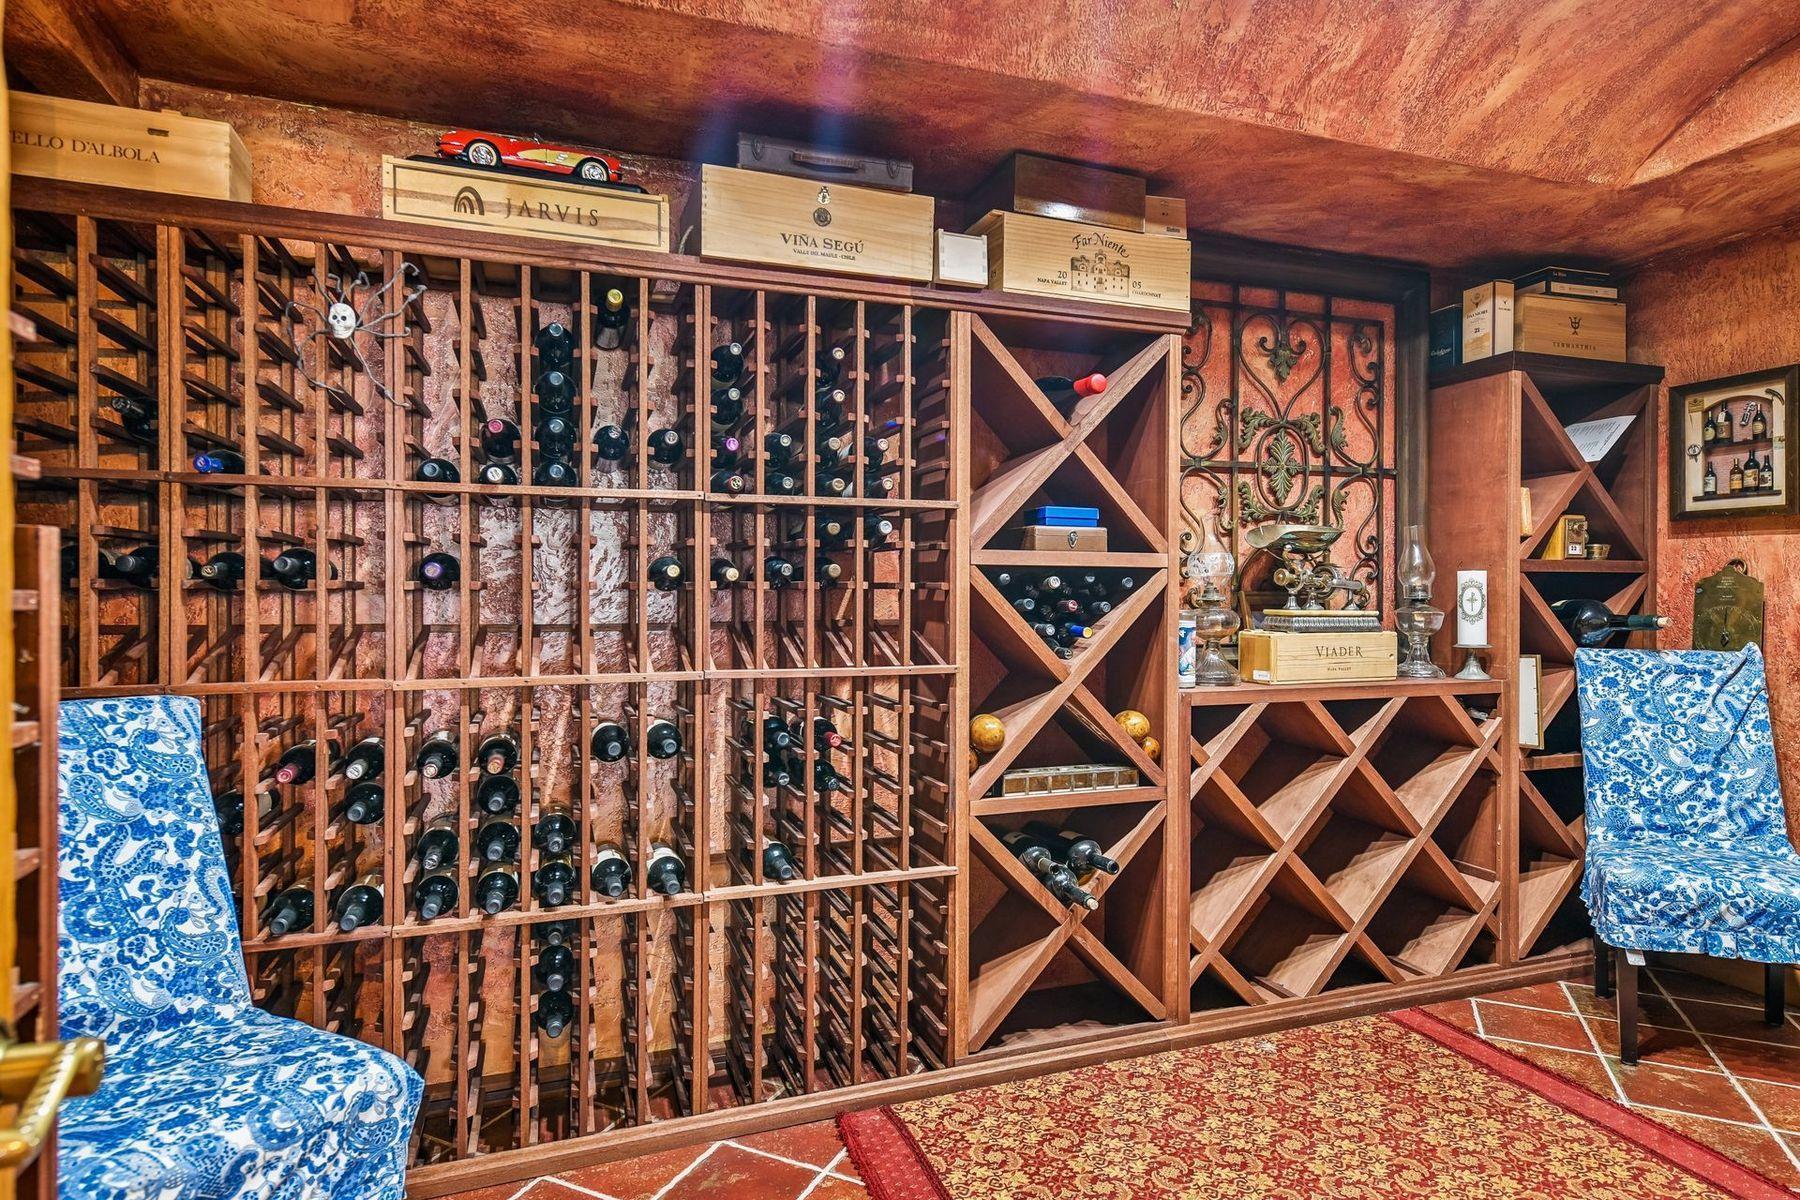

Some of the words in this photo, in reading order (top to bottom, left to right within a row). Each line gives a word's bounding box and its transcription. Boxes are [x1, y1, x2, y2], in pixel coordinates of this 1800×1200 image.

[72, 139, 161, 164] D'ALBOLA
[503, 197, 599, 227] JARVIS
[780, 232, 819, 249] VIÑA
[822, 237, 865, 254] SEGÚ
[1071, 234, 1093, 250] Far
[1092, 232, 1130, 259] Niente
[1057, 270, 1068, 280] 20
[1131, 280, 1142, 289] 05
[1315, 645, 1365, 658] VIADER
